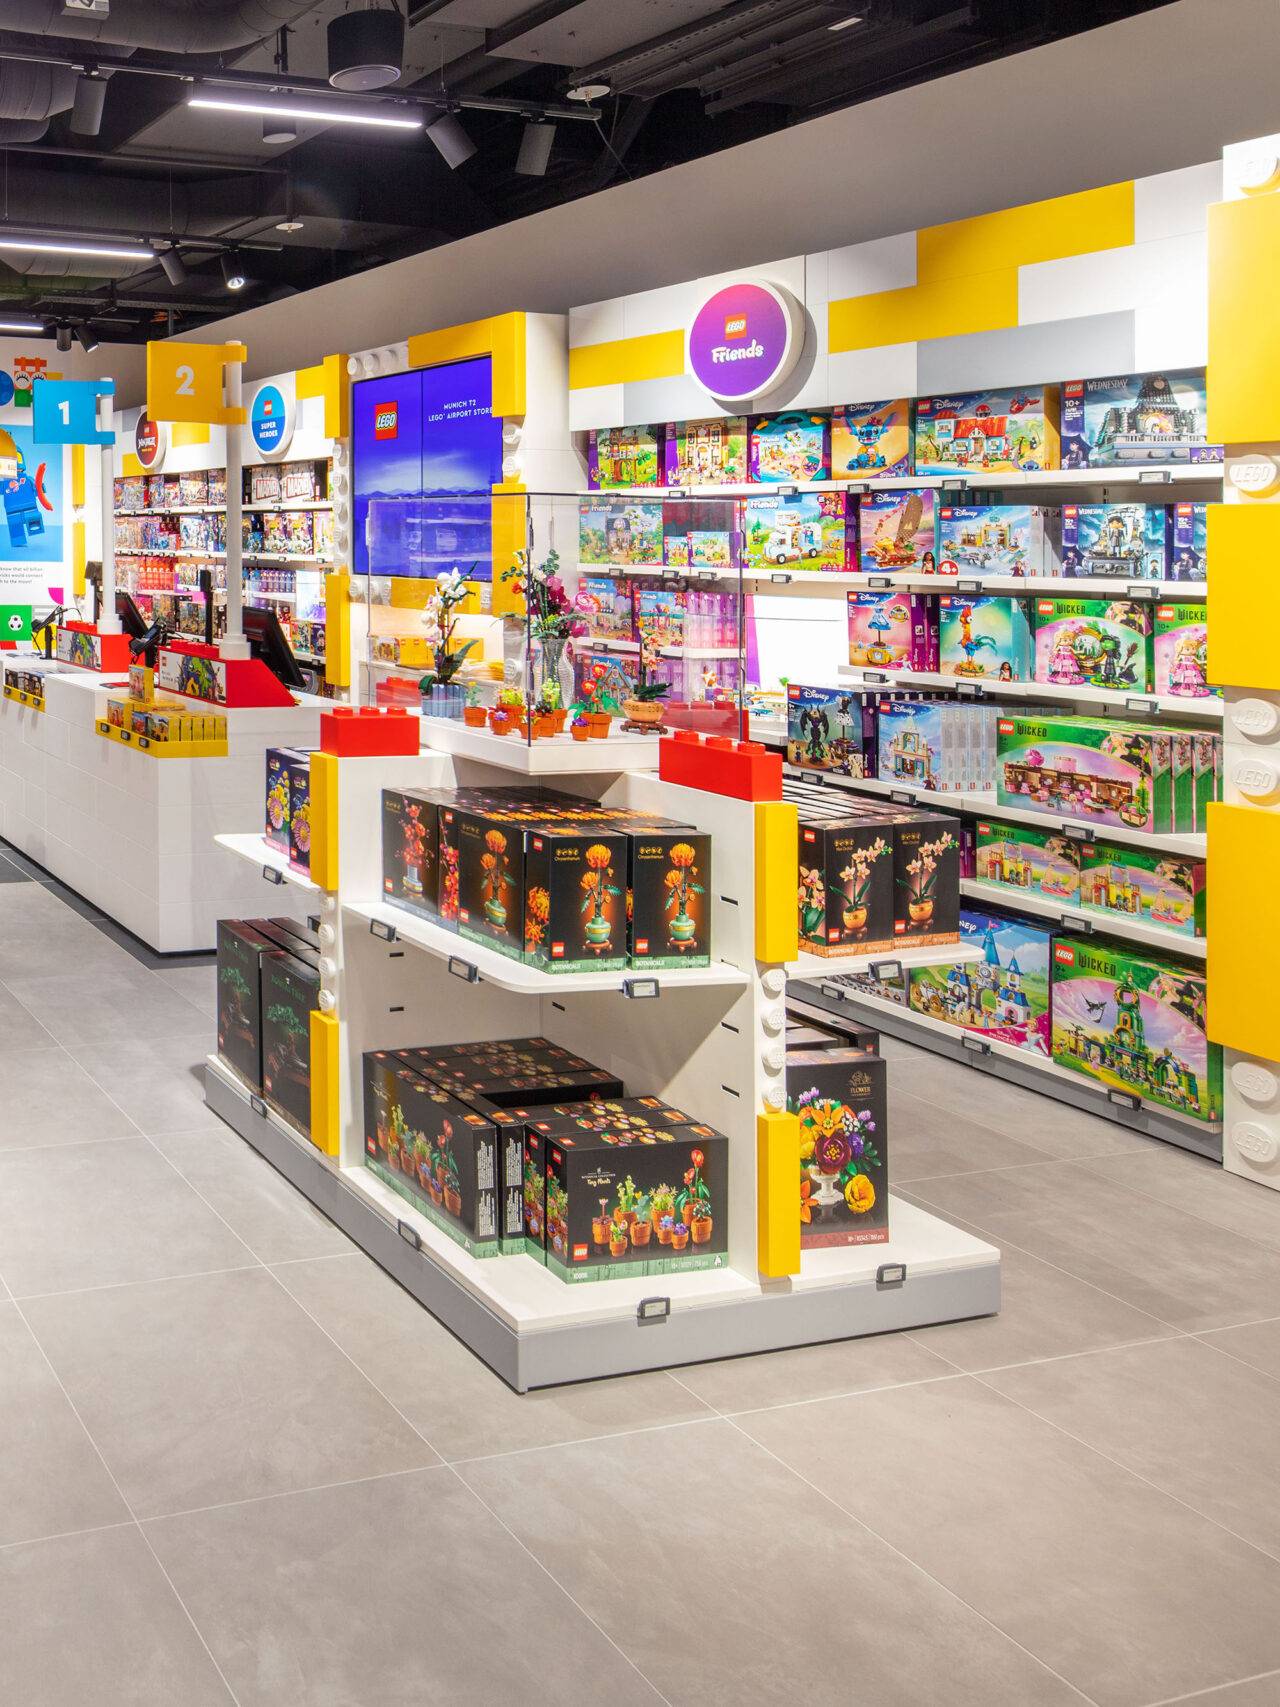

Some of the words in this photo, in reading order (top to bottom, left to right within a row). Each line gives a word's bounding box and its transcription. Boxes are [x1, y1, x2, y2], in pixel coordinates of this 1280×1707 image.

[725, 320, 745, 333] LEGO
[711, 339, 764, 364] Friends
[175, 365, 195, 395] 2
[1066, 384, 1082, 393] LEGO
[1087, 379, 1128, 391] WEDNESDAY
[443, 401, 467, 410] MUNICH
[468, 399, 476, 407] T2
[848, 403, 876, 413] Disney
[933, 398, 964, 410] Disney
[1065, 400, 1080, 408] 10+
[58, 401, 70, 425] 1
[447, 409, 472, 420] AIRPORT
[474, 407, 493, 416] STORE
[376, 412, 396, 429] LEGO
[259, 430, 278, 439] HEROES
[1234, 464, 1270, 483] LEGO
[750, 498, 779, 510] Friends
[874, 493, 902, 505] Disney
[591, 504, 612, 513] Friends
[953, 508, 978, 518] Disney
[941, 563, 957, 574] 4+
[858, 592, 879, 602] Disney
[951, 596, 976, 607] Disney
[1038, 603, 1054, 612] LEGO
[1056, 602, 1086, 615] WICKED
[1156, 609, 1174, 618] LEGO
[1177, 608, 1207, 621] WICKE
[801, 687, 830, 702] Disney
[891, 702, 917, 715] Disney
[1235, 709, 1270, 727] LEGO
[1017, 722, 1047, 738] WICKED
[1235, 768, 1271, 787] LEGO
[992, 826, 1015, 839] WICKED
[1097, 847, 1122, 862] WICKED
[635, 959, 665, 967] BOTANICALS
[1056, 949, 1073, 961] LEGO
[1078, 951, 1116, 977] WICKED
[1056, 965, 1066, 973] 9+
[988, 1031, 1022, 1046] PRINCESS
[850, 1086, 871, 1094] FLOWER
[587, 1179, 597, 1187] Tiny
